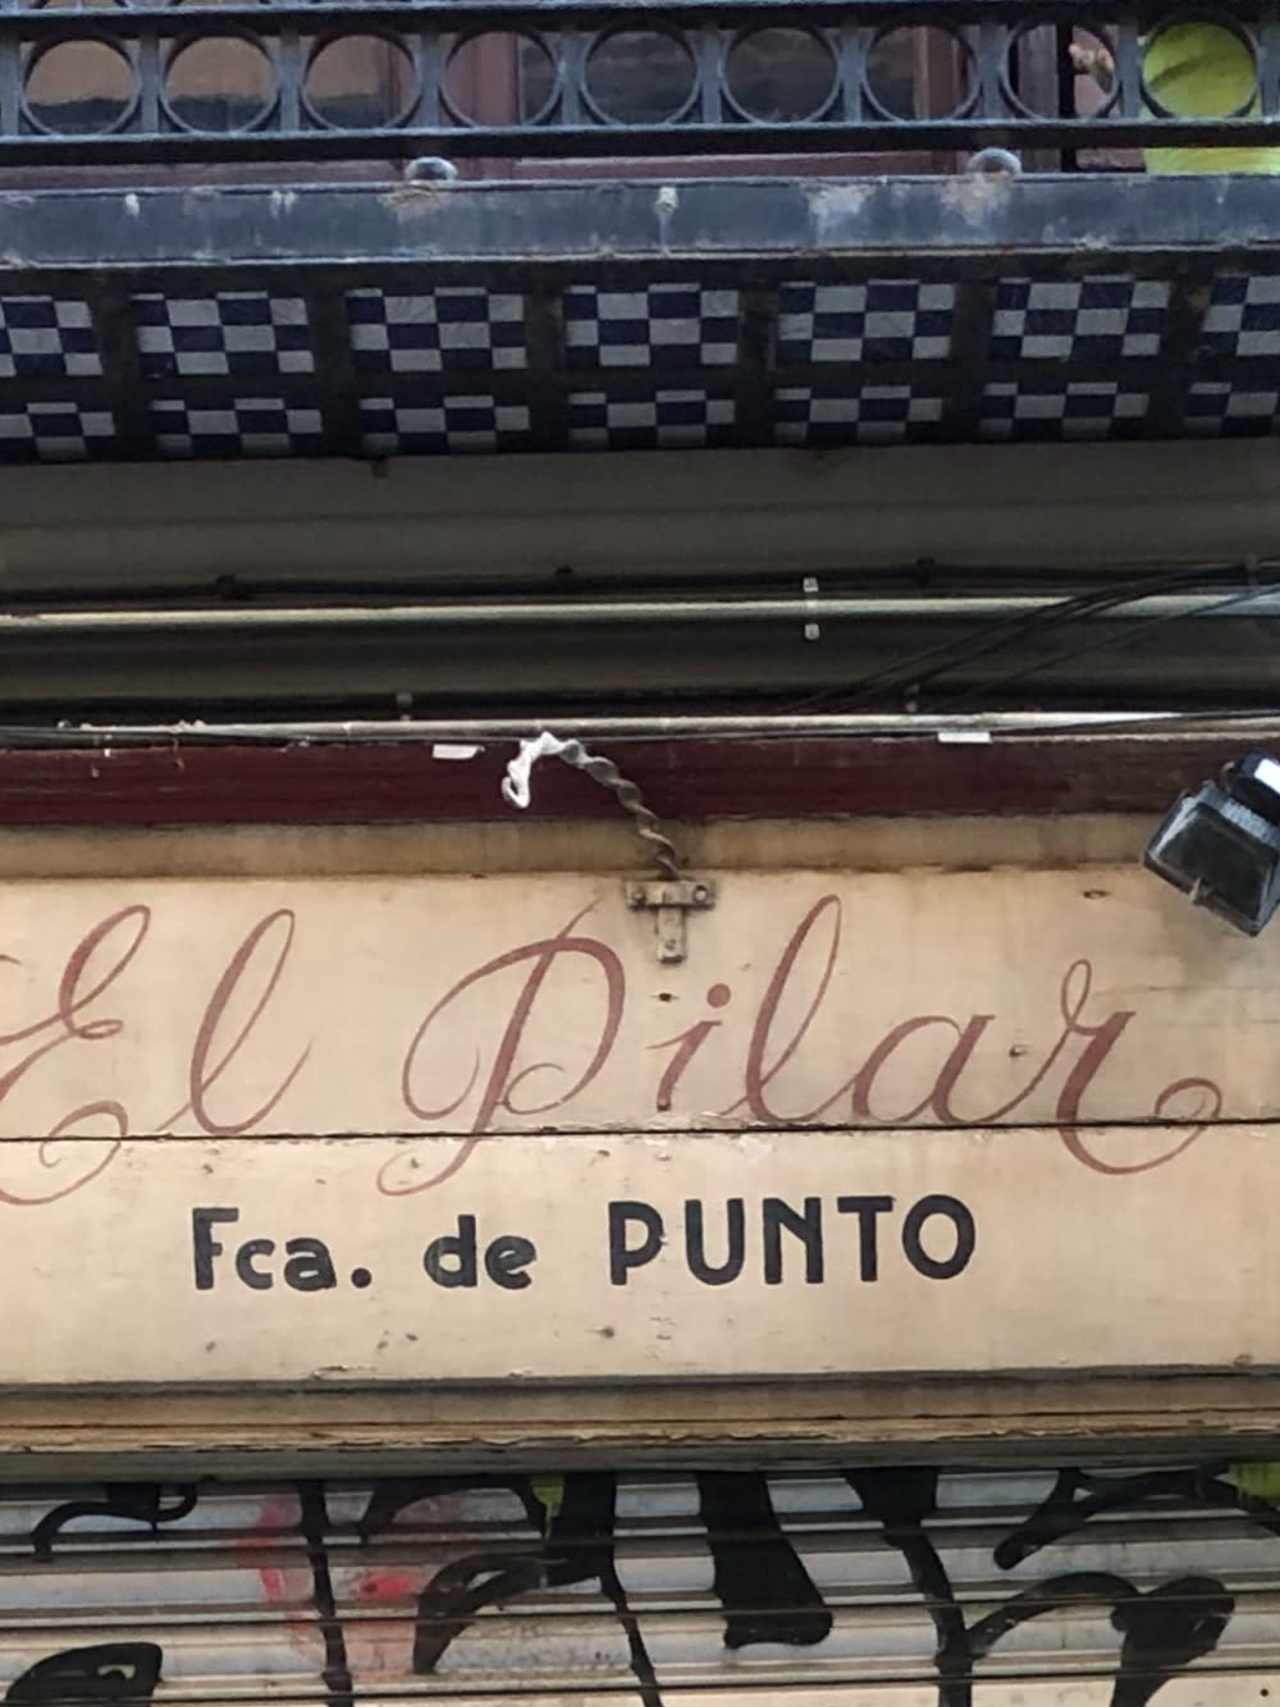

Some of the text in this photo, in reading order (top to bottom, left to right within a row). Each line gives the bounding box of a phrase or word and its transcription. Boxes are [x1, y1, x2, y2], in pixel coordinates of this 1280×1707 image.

[377, 894, 1223, 1197] Pilar
[191, 1194, 978, 1293] Fca. de PUNTO
